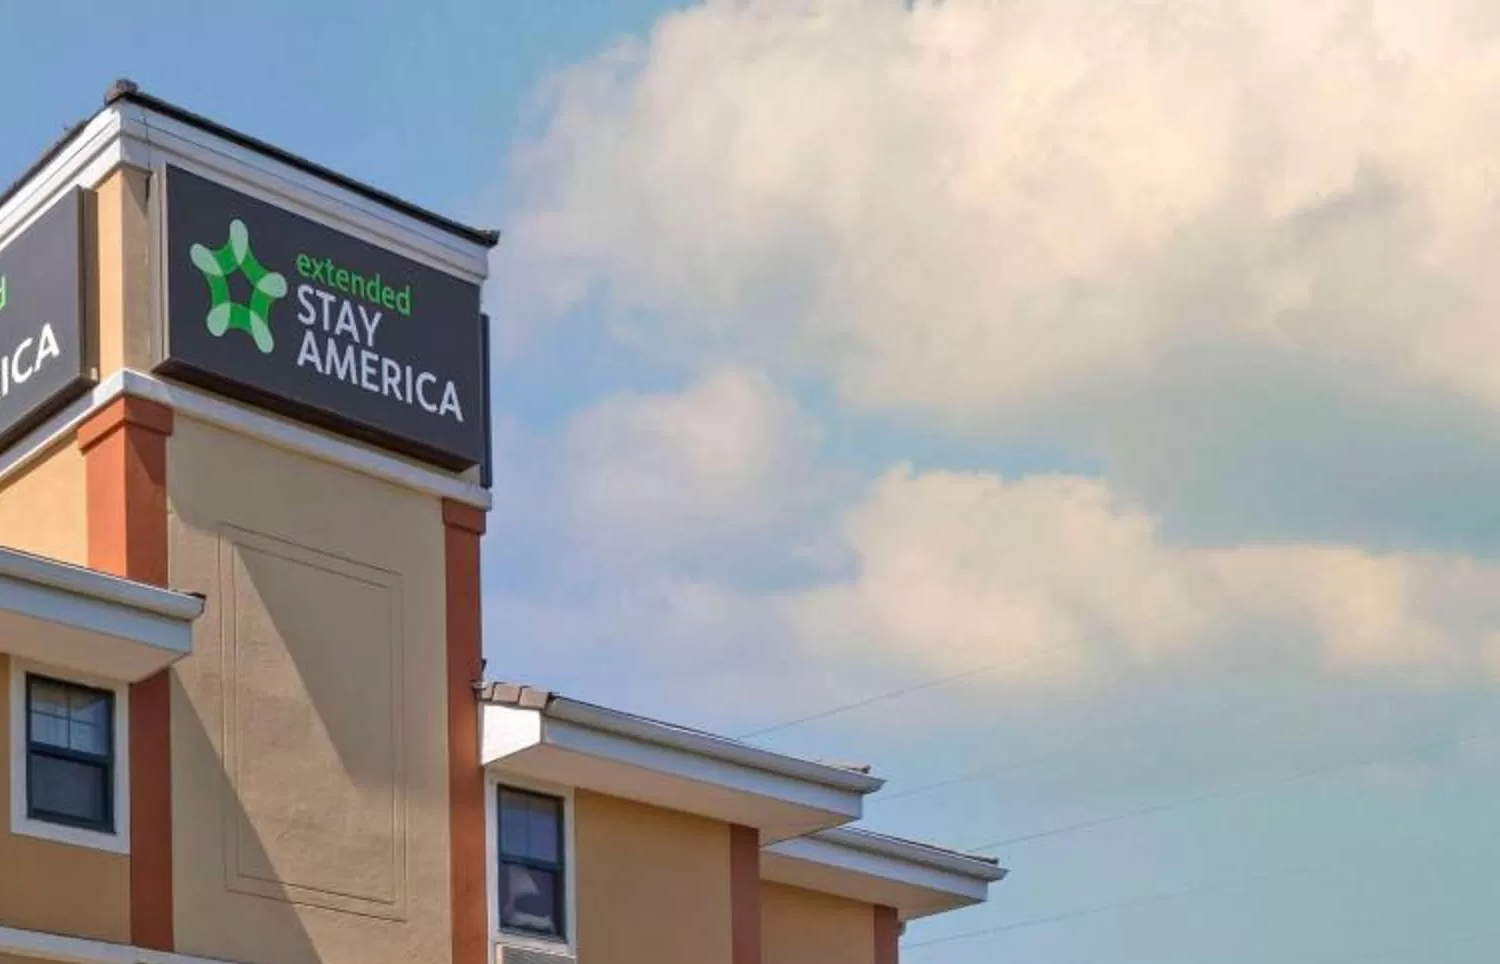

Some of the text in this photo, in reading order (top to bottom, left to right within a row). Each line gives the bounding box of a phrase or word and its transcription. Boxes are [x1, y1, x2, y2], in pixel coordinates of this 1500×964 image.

[296, 253, 411, 316] extended
[297, 283, 382, 347] STAY
[297, 329, 464, 422] AMERICA
